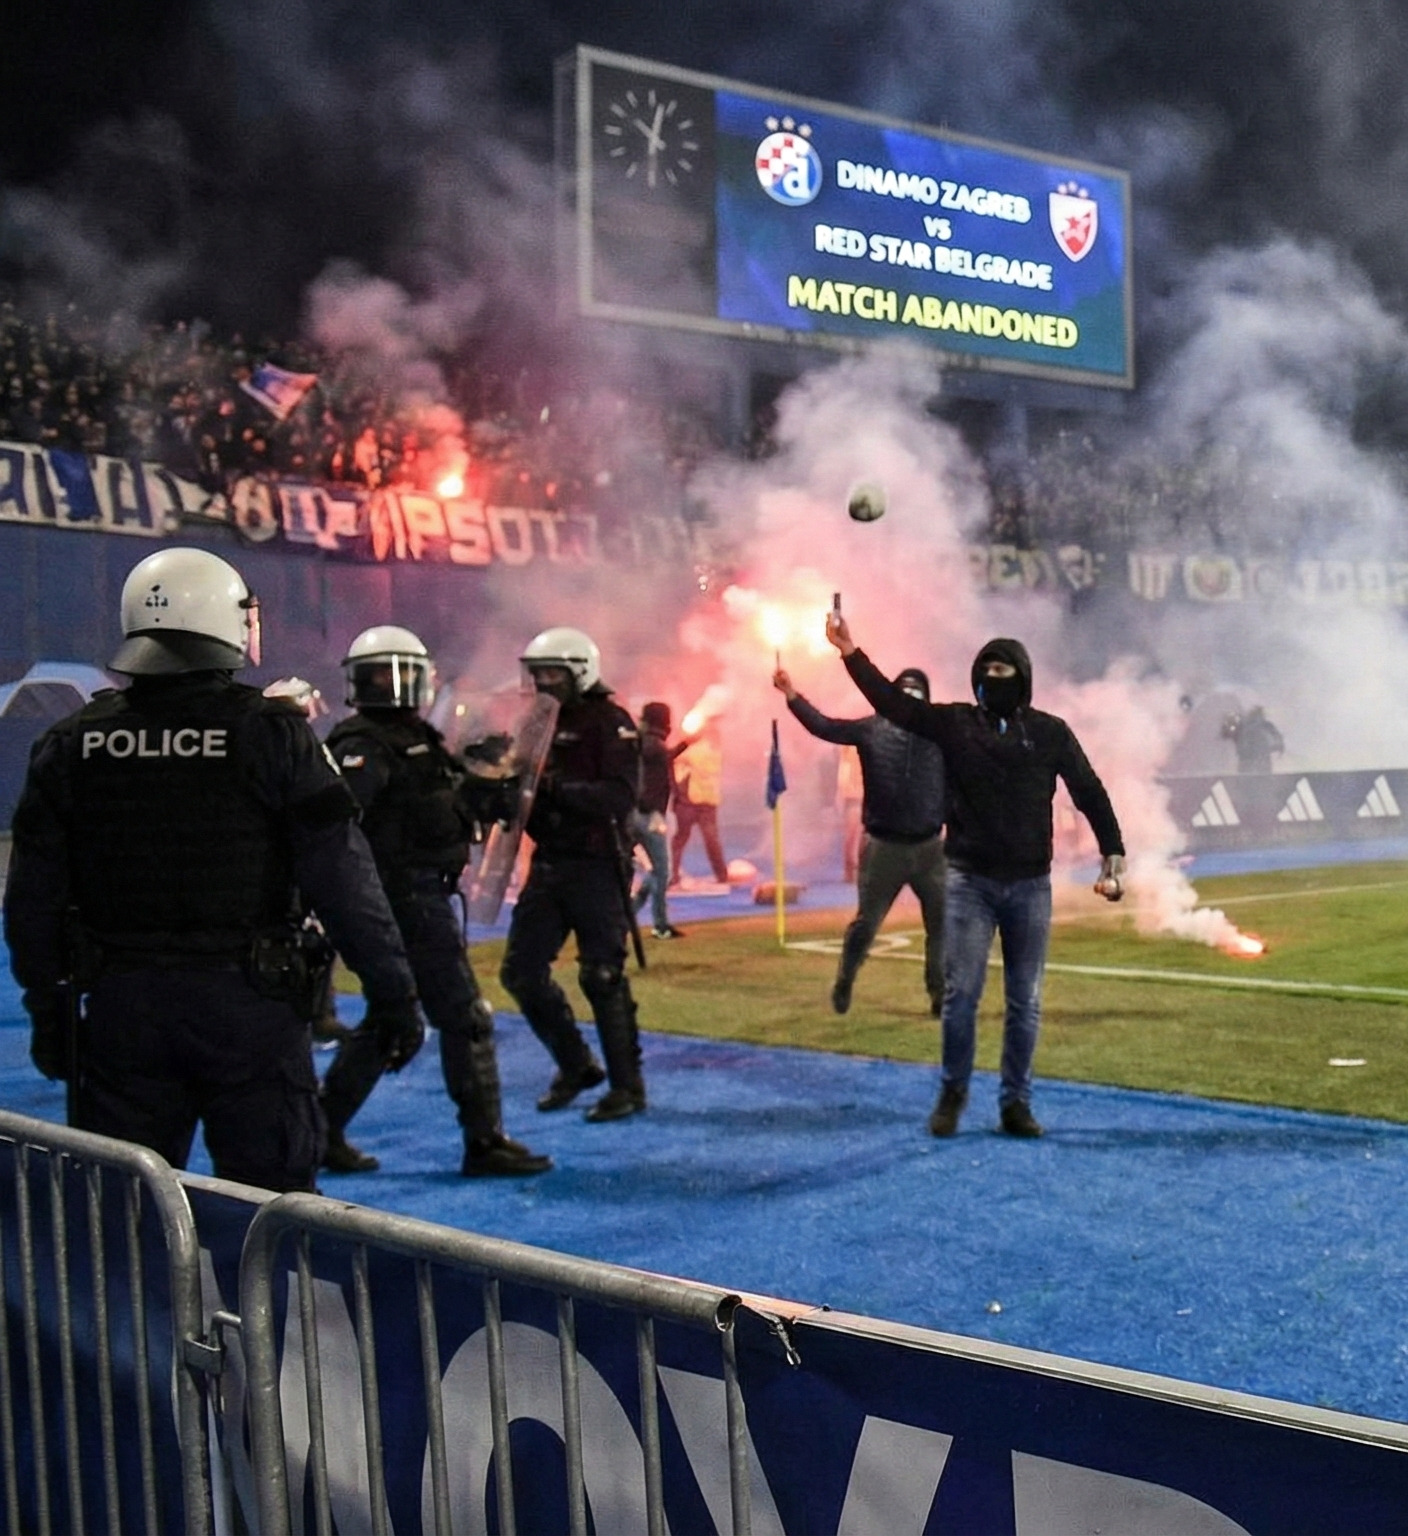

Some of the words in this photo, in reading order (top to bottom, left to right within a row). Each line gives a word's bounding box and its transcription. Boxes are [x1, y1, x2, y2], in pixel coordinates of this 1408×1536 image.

[837, 160, 939, 204] DINAMO
[940, 181, 1031, 223] ZAGREB
[815, 224, 867, 258] RED
[869, 234, 932, 270] STAR
[934, 246, 1053, 290] BELGRADE
[788, 275, 898, 323] MATCH
[901, 294, 1078, 349] ABANDONED
[82, 728, 228, 760] POLICE
